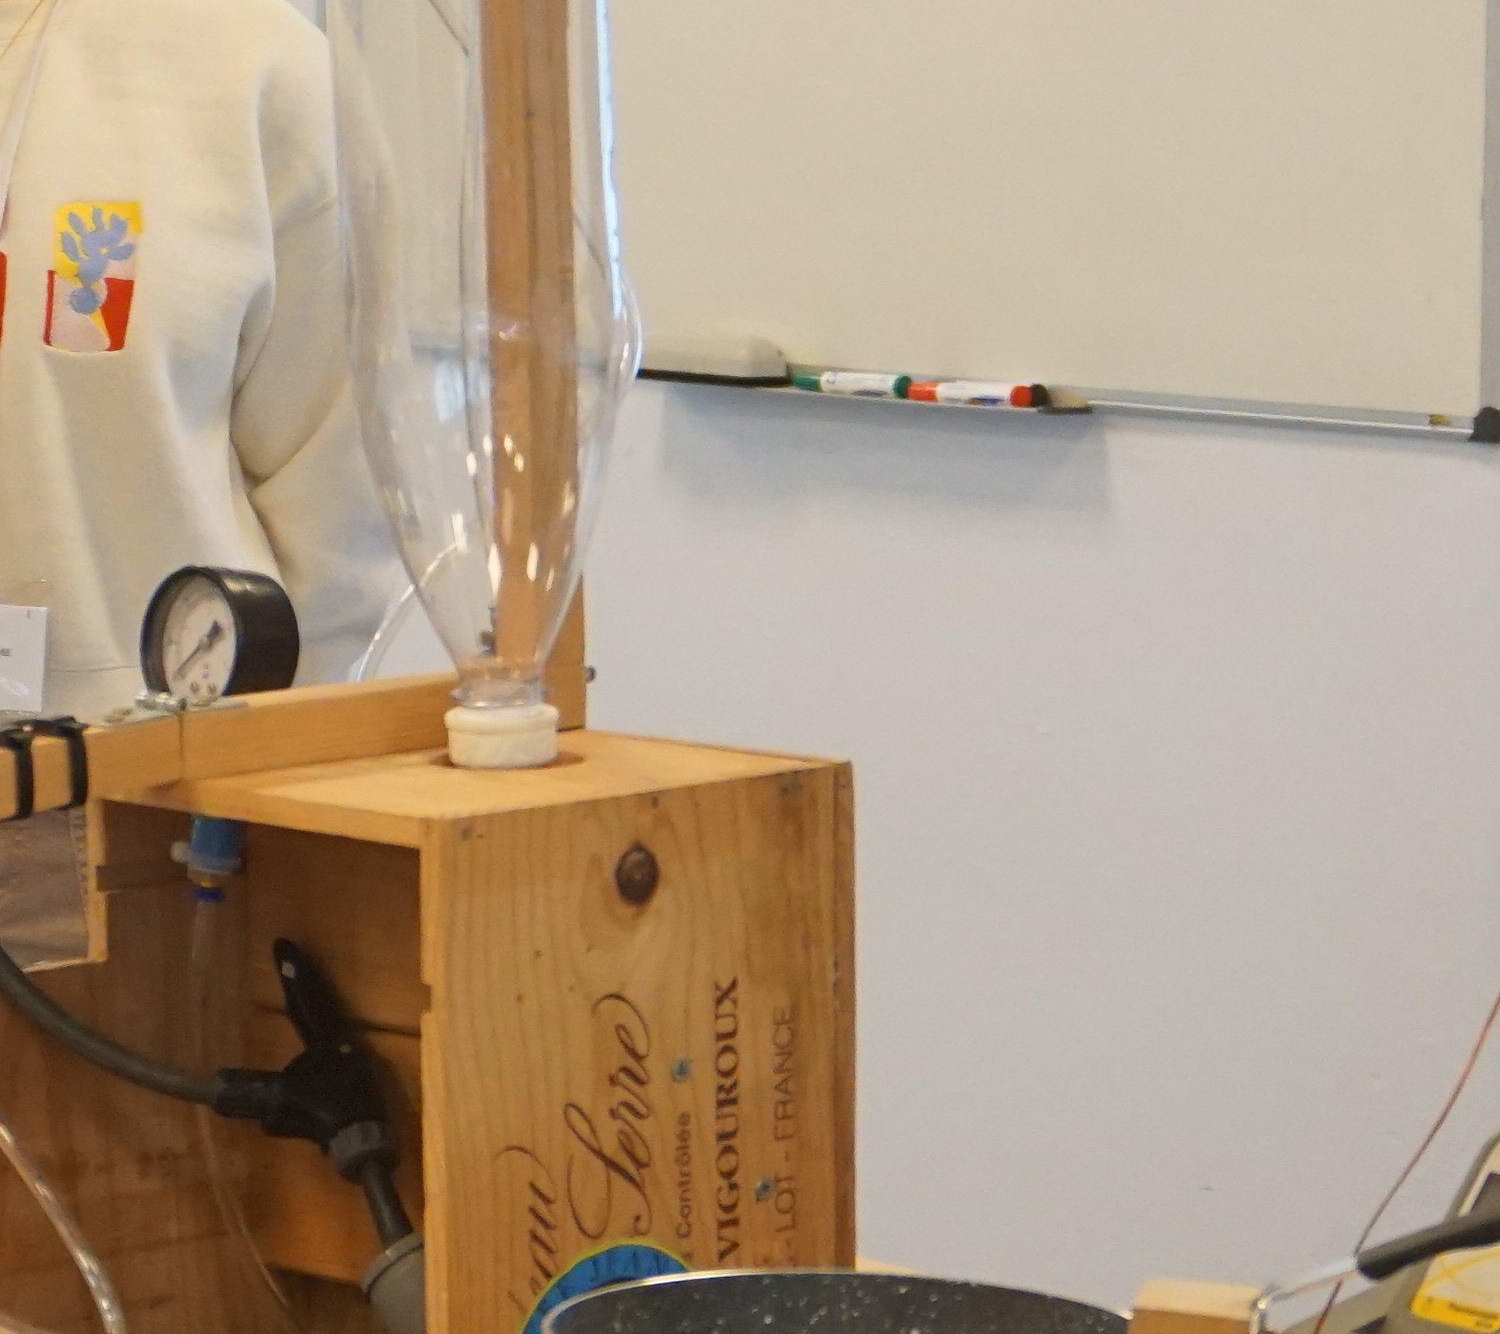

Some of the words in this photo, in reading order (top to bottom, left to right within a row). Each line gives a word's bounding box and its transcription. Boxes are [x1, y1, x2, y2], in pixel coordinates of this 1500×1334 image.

[563, 992, 652, 1240] Serre
[714, 975, 742, 1264] VIGOUROUX
[772, 1006, 798, 1142] FRANCE
[773, 1173, 798, 1234] LOT
